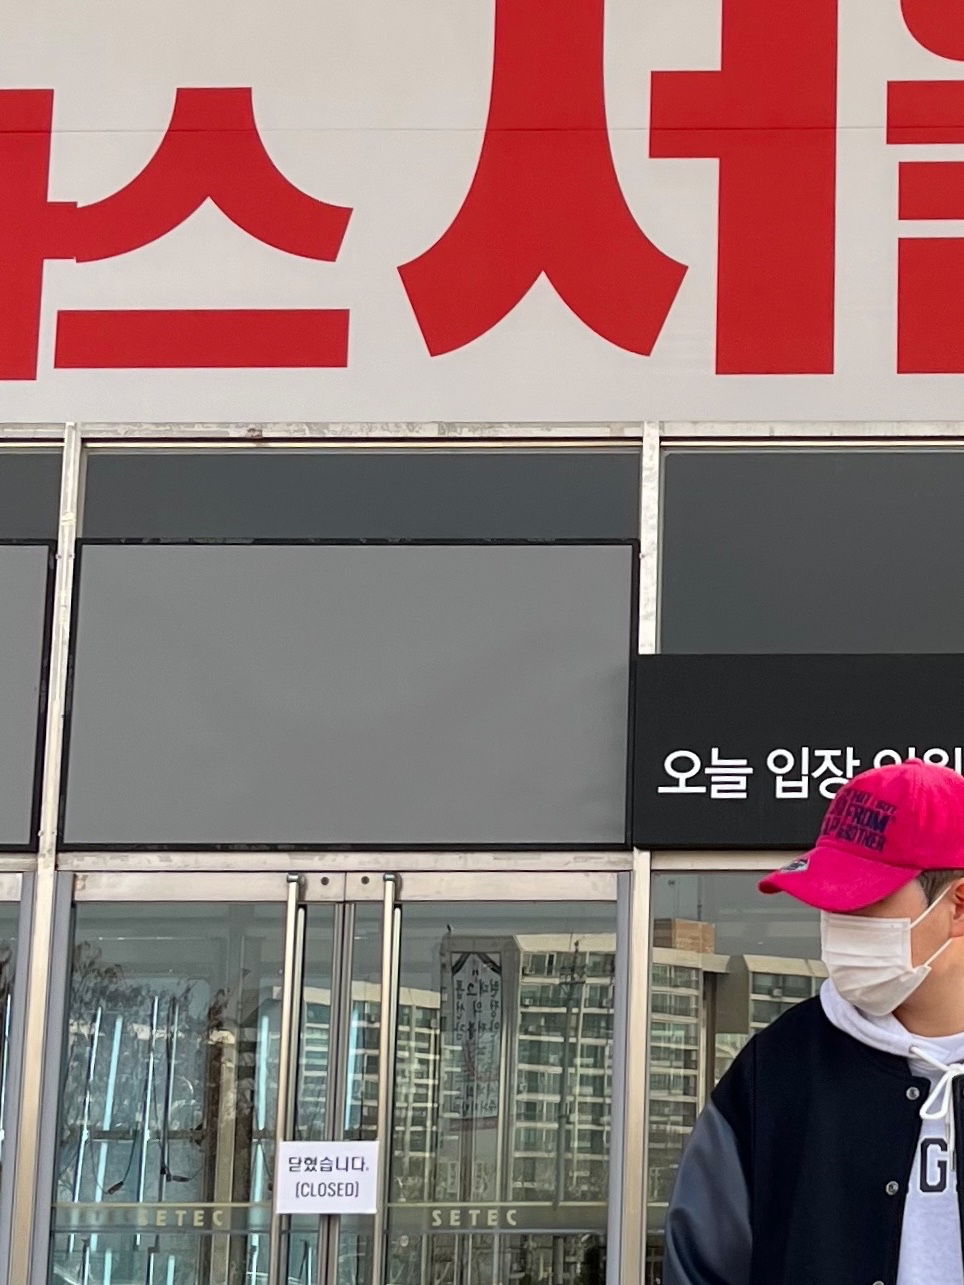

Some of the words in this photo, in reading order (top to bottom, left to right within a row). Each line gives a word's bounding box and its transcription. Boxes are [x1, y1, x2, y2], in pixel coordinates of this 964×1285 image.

[658, 747, 753, 799] 오늘
[767, 747, 860, 799] 입장
[288, 1156, 370, 1173] 닫혔습니다.
[919, 1137, 949, 1193] G
[137, 1209, 226, 1228] SETEC
[431, 1209, 519, 1227] SETEC
